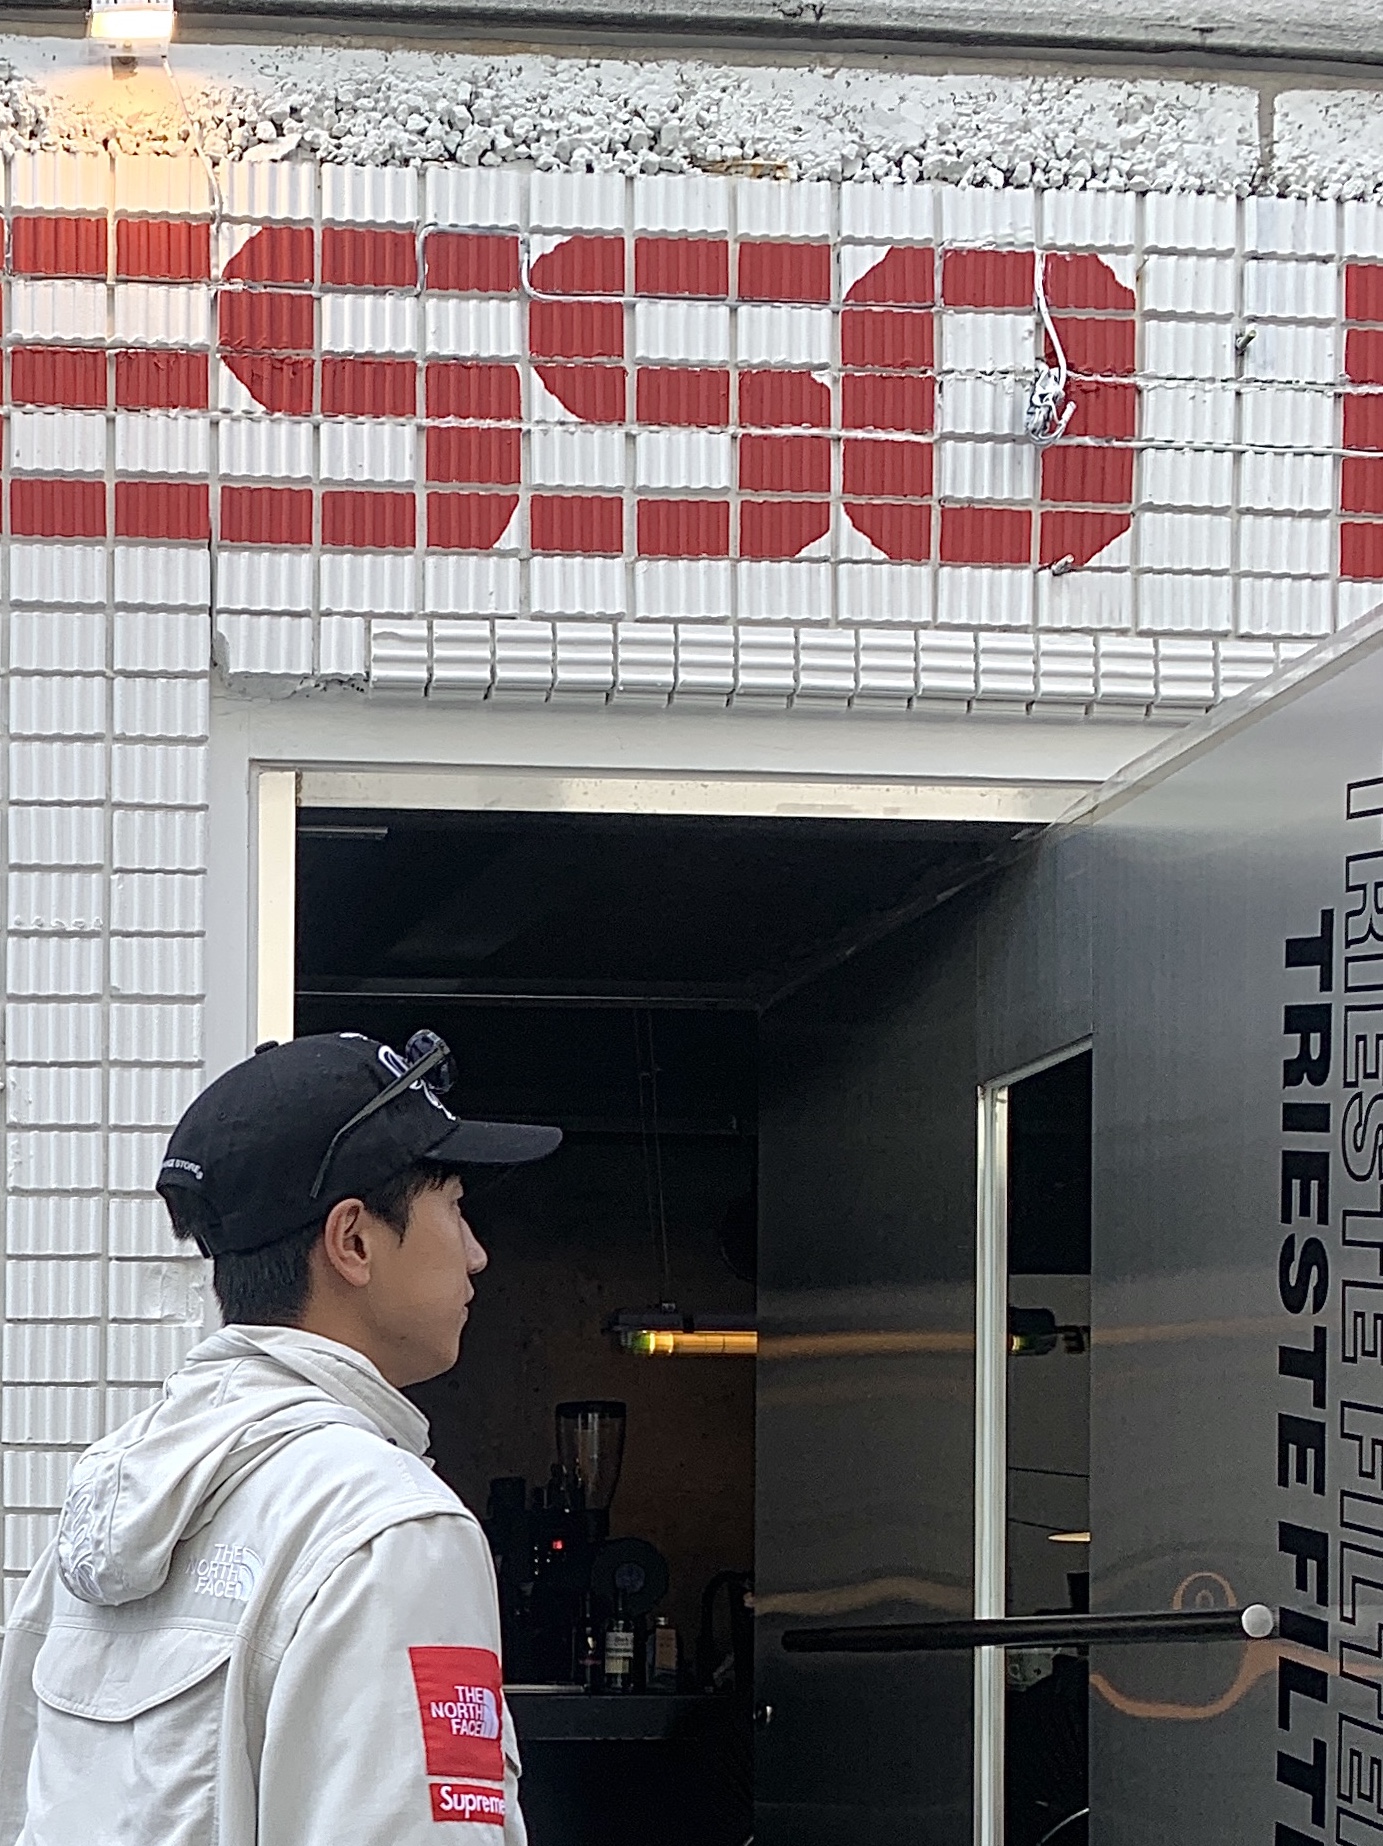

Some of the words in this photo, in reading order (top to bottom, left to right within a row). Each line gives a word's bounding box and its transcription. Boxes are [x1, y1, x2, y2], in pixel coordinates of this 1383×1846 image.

[1277, 908, 1336, 1497] TRIESTE
[214, 1544, 244, 1563] THE
[186, 1558, 241, 1583] NORTH
[194, 1577, 238, 1599] FACE
[454, 1685, 484, 1703] THE
[430, 1701, 483, 1721] NORTH
[451, 1718, 482, 1737] FACE
[440, 1785, 506, 1819] Supreme
